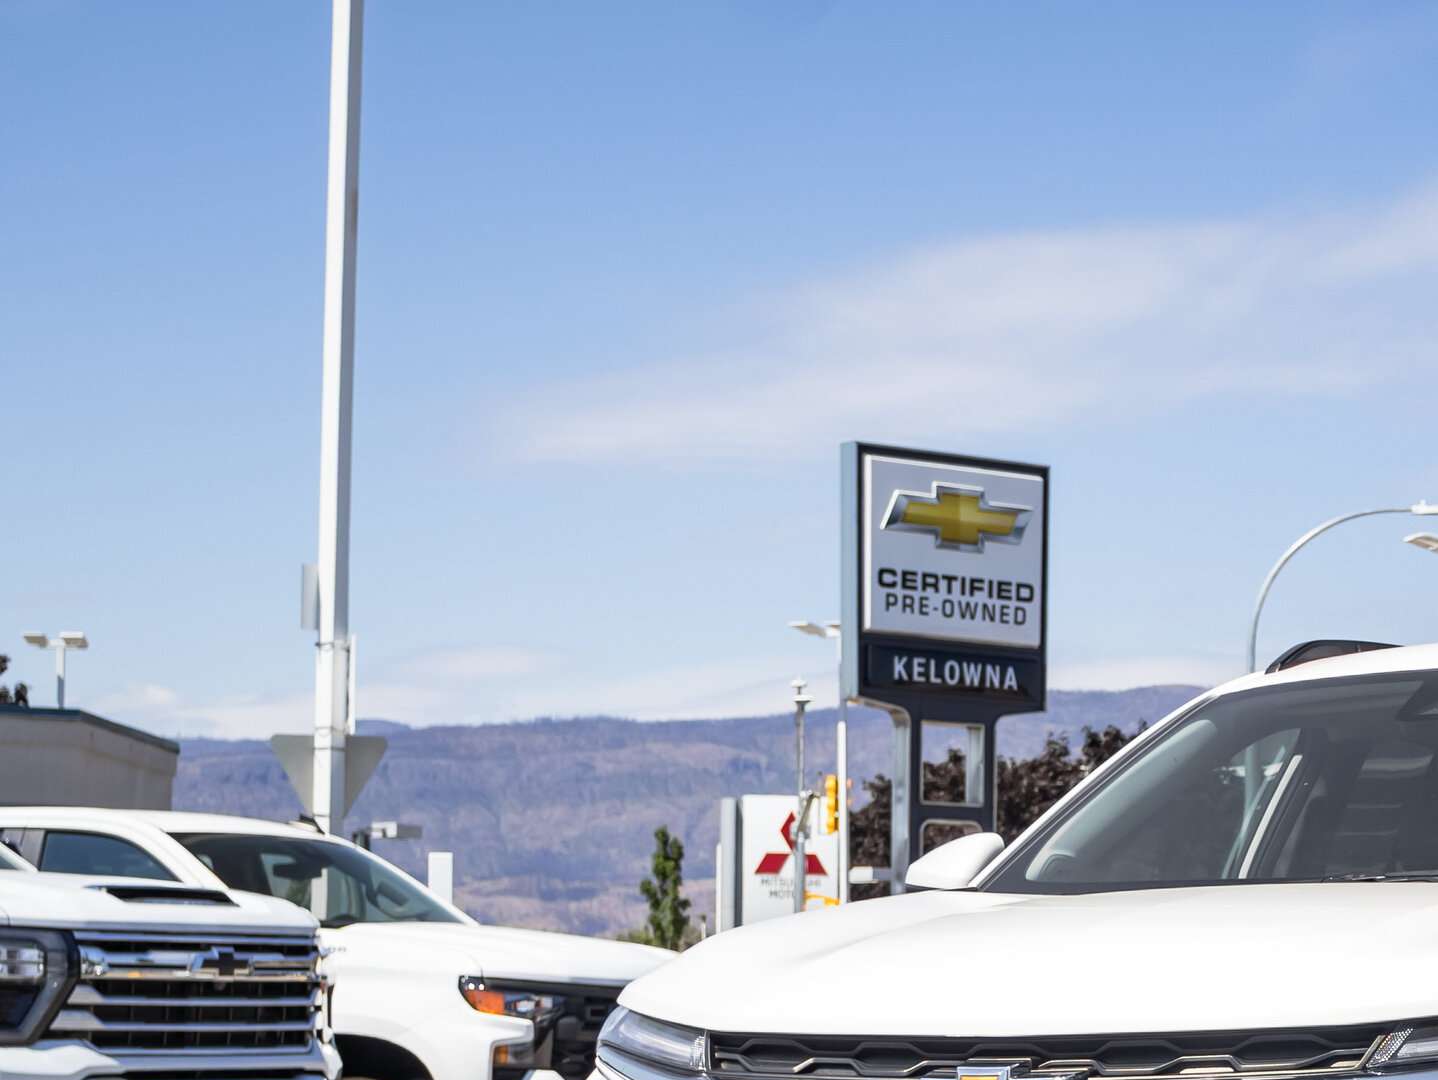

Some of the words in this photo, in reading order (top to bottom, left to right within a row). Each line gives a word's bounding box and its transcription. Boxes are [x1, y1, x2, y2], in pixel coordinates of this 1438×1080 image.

[877, 567, 1035, 603] CERTIFIED
[885, 592, 1027, 626] PRE-OWNED
[893, 655, 1019, 691] KELOWNA
